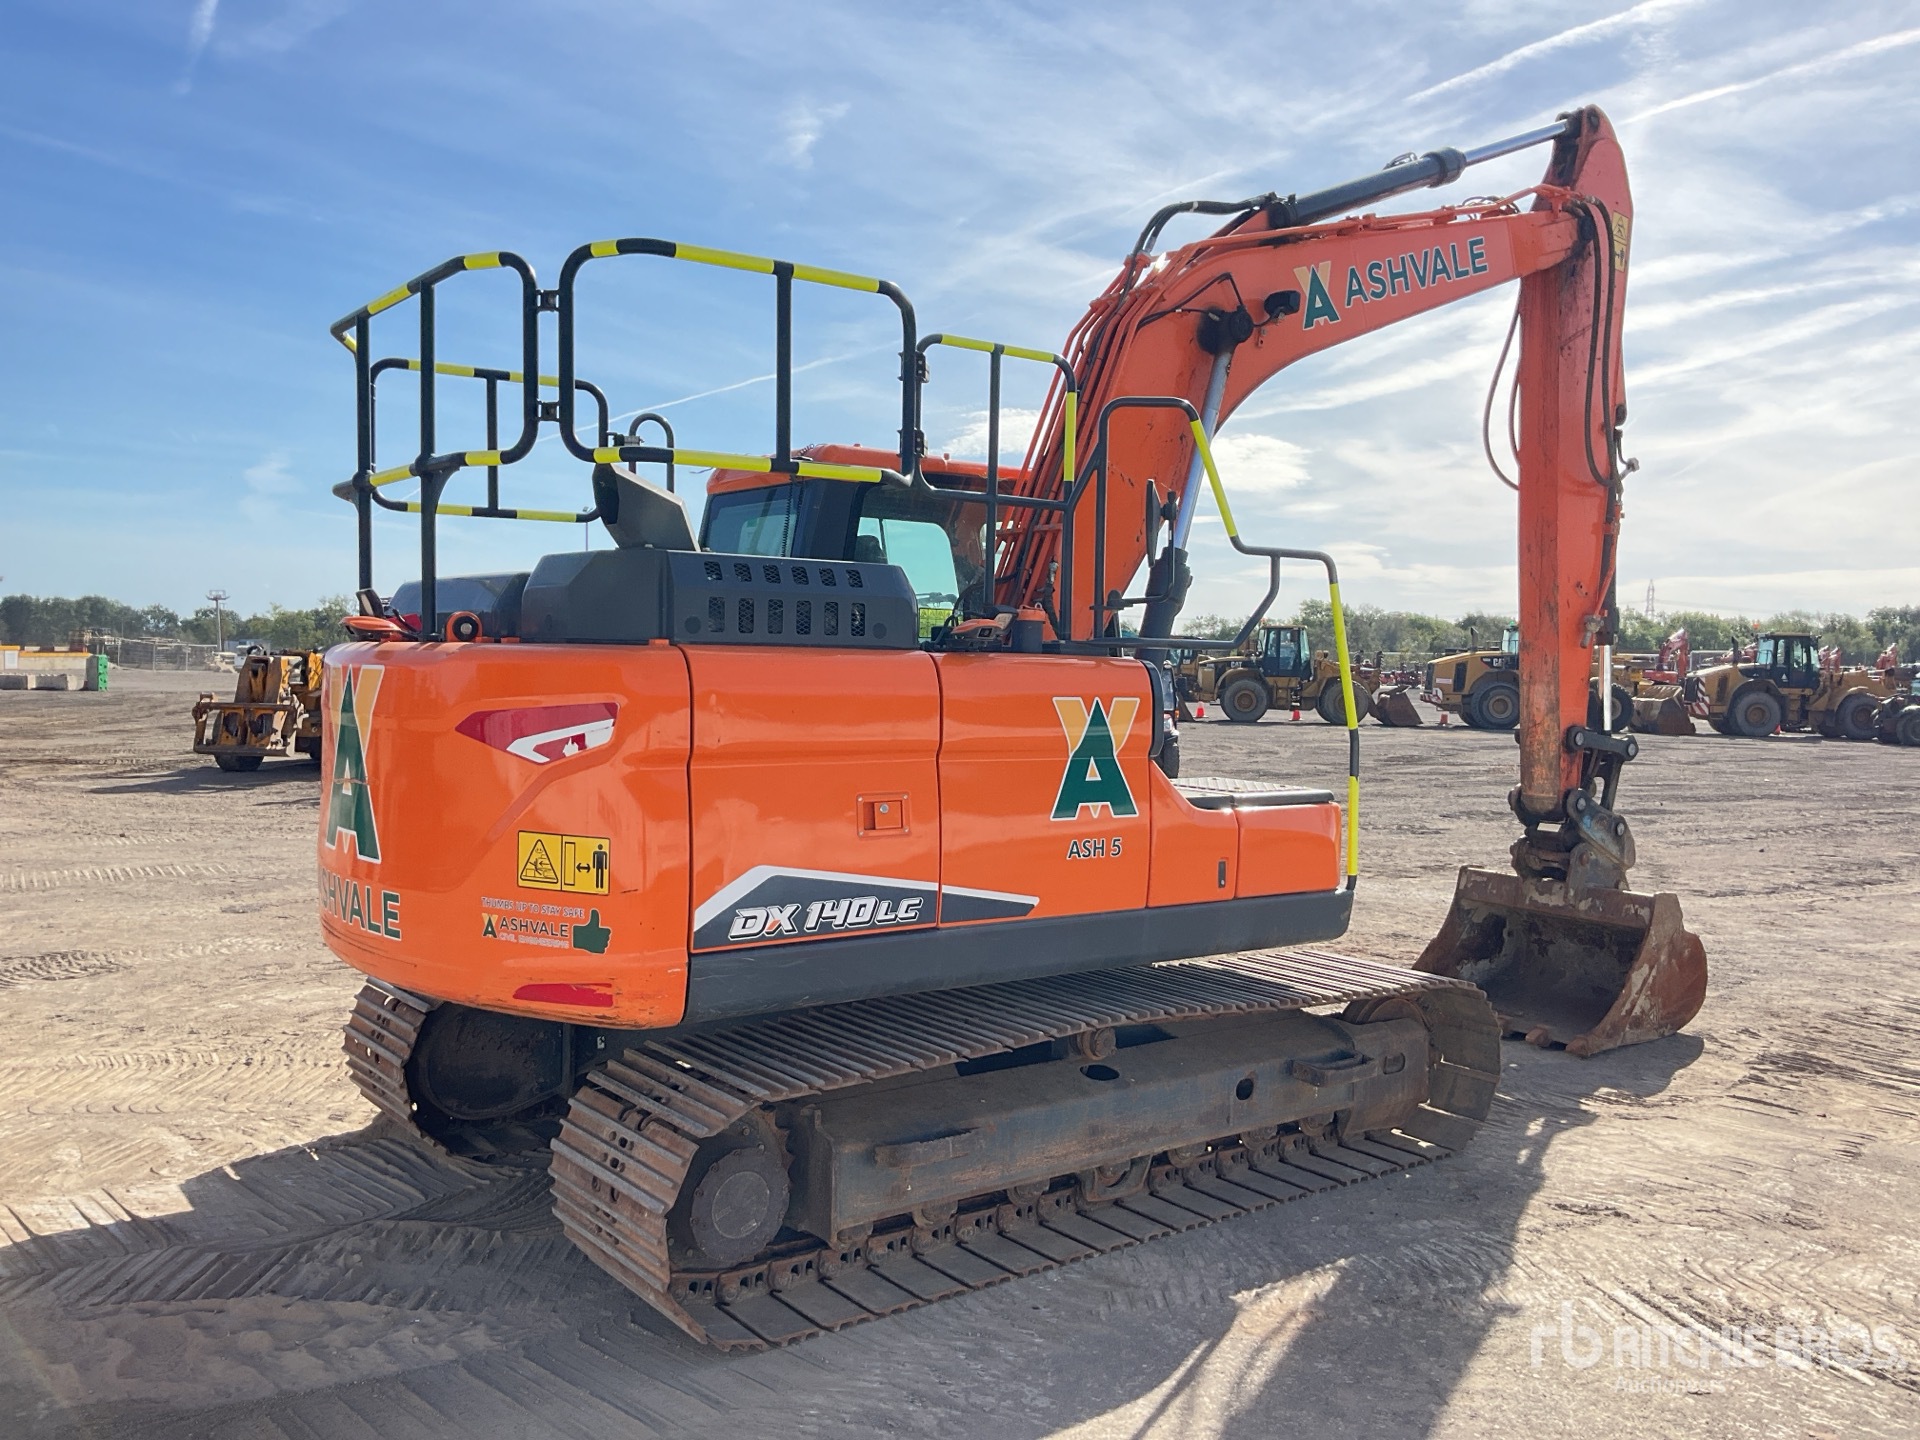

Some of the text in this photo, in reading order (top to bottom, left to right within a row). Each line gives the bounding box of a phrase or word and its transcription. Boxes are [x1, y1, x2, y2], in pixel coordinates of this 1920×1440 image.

[1345, 237, 1488, 308] ASHVALE
[1066, 837, 1122, 860] ASH 5
[319, 867, 402, 941] SHVALE
[481, 897, 585, 919] THUMBS UP TO STAY SAFE
[500, 916, 569, 938] ASHVALE
[728, 904, 801, 940] DX
